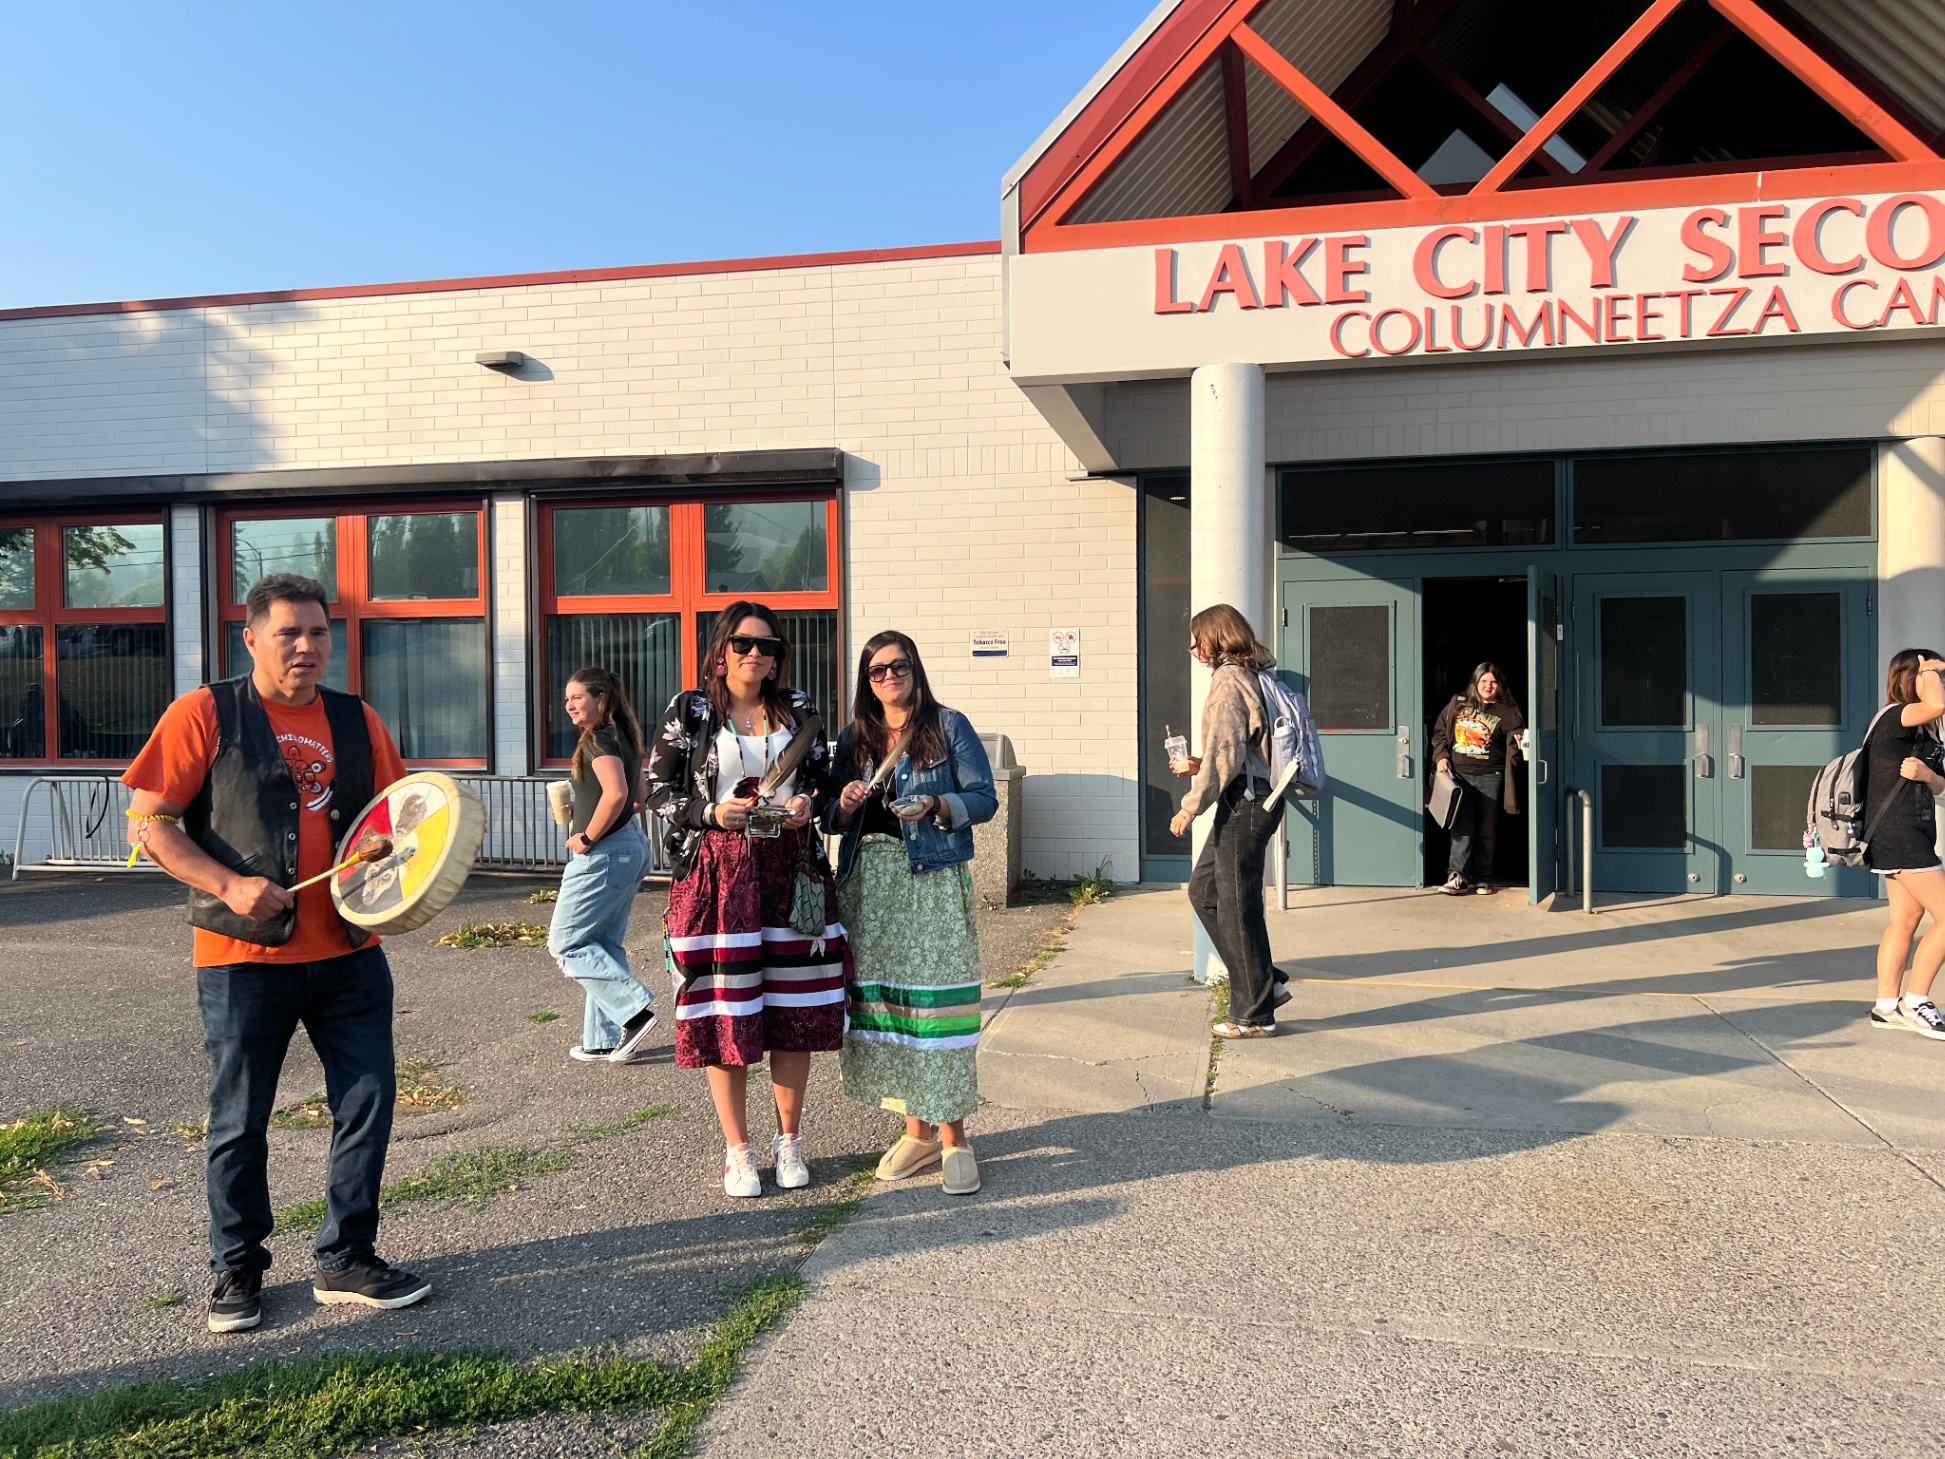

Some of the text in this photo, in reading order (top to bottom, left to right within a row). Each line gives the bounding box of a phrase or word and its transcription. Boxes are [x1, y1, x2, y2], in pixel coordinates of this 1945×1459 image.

[1154, 234, 1368, 315] LAKE
[1412, 215, 1635, 300] CITY
[1329, 284, 1798, 358] COLUMNEETZA
